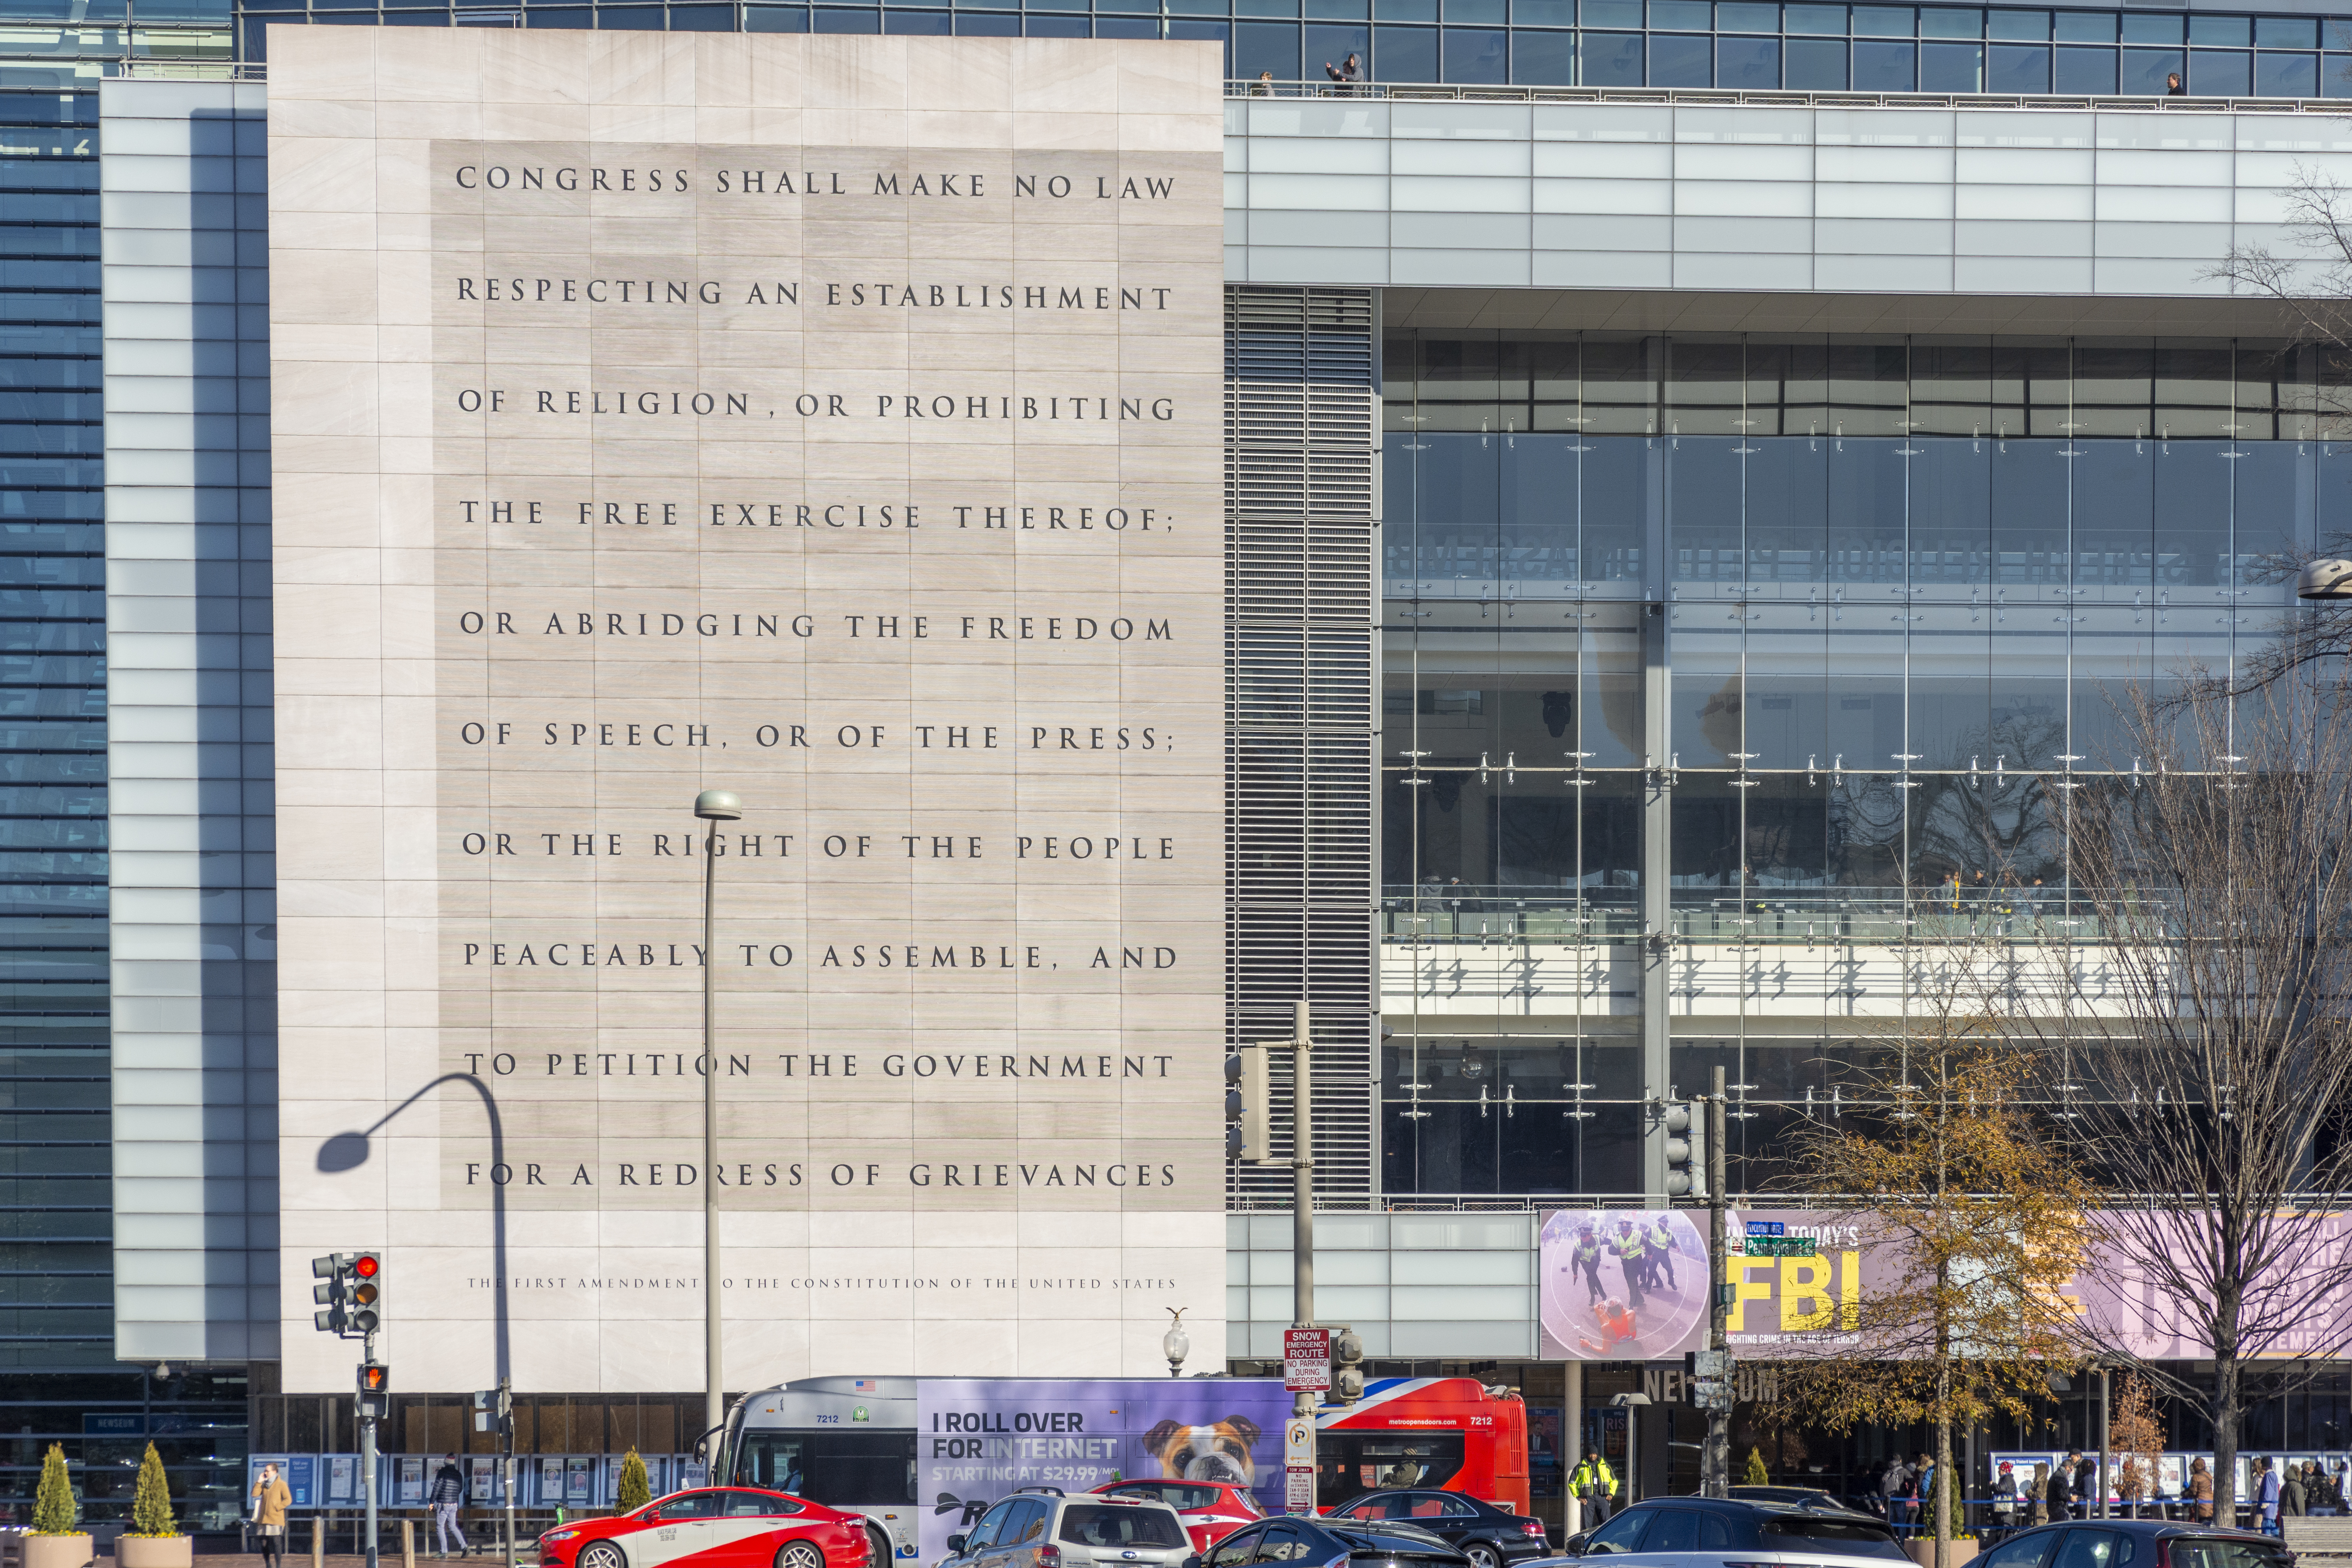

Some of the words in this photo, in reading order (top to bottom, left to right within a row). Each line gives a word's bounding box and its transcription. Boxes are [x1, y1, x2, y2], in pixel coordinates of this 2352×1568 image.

[456, 166, 688, 192] CONGRESS
[717, 170, 846, 195] SHALL
[873, 172, 984, 197] MAKE
[1015, 175, 1071, 198] NO
[1097, 176, 1174, 200] LAW
[457, 278, 722, 304] RESPECTING
[747, 282, 798, 305] AN
[826, 283, 1171, 310] ESTABLISHMENT
[458, 389, 504, 412] OF
[795, 394, 849, 416] OR
[878, 395, 1174, 421] PROHIBITING
[459, 500, 542, 524] THE
[577, 502, 677, 526] FREE
[710, 504, 920, 528] EXERCISE
[952, 506, 1172, 533] THEREOF;
[460, 611, 517, 634] OR
[544, 612, 814, 638] ABRIDGING
[844, 615, 928, 638] THE
[961, 617, 1173, 641] FREEDOM
[461, 722, 511, 745] OF
[545, 723, 727, 749] SPEECH,
[756, 725, 811, 747] OR
[837, 725, 884, 748] OF
[915, 726, 998, 749] THE
[1031, 727, 1172, 752] PRESS;
[462, 833, 517, 855] OR
[541, 833, 622, 856] THE
[653, 834, 793, 857] RIGHT
[824, 835, 870, 858] OF
[901, 835, 982, 858] THE
[1017, 837, 1173, 859] PEOPLE
[464, 943, 706, 966] PEACEABLY
[739, 944, 793, 967] TO
[821, 944, 1057, 970] ASSEMBLE,
[1089, 946, 1176, 969] AND
[465, 1053, 516, 1076] TO
[546, 1053, 751, 1076] PETITION
[779, 1054, 857, 1076] THE
[883, 1054, 1173, 1078] GOVERNMENT
[466, 1163, 546, 1185] FOR
[571, 1163, 592, 1185] A
[831, 1164, 879, 1186] OF
[909, 1164, 1174, 1187] GRIEVANCES
[1747, 1224, 1769, 1233] EVACUATION
[1770, 1224, 1782, 1233] ROUTE
[1748, 1239, 1802, 1255] Pennsylvania
[2295, 1242, 2344, 1266] THE
[468, 1278, 502, 1288] THE
[515, 1278, 566, 1288] FIRST
[578, 1278, 699, 1288] AMENDMENT
[723, 1279, 733, 1288] O
[745, 1279, 779, 1288] THE
[791, 1279, 938, 1288] CONSTITUTION
[950, 1279, 972, 1288] OF
[984, 1279, 1018, 1288] THE
[1030, 1279, 1101, 1289] UNITED
[1113, 1279, 1176, 1289] STATES
[1726, 1251, 1860, 1331] FBI
[1293, 1332, 1321, 1341] SNOW
[1726, 1334, 1757, 1344] FIGHTING
[1759, 1334, 1781, 1344] CRIME
[1783, 1334, 1790, 1344] IN
[1290, 1349, 1324, 1358] ROUTE
[1644, 1370, 1778, 1402] NEUM
[98, 1419, 135, 1427] NEWSEUM
[933, 1413, 938, 1432] I
[946, 1413, 1010, 1432] ROLL
[1015, 1413, 1083, 1432] OVER
[933, 1438, 983, 1458] FOR
[989, 1438, 1117, 1458] INTERNET
[932, 1467, 1015, 1480] STARTING
[1018, 1467, 1039, 1480] AT
